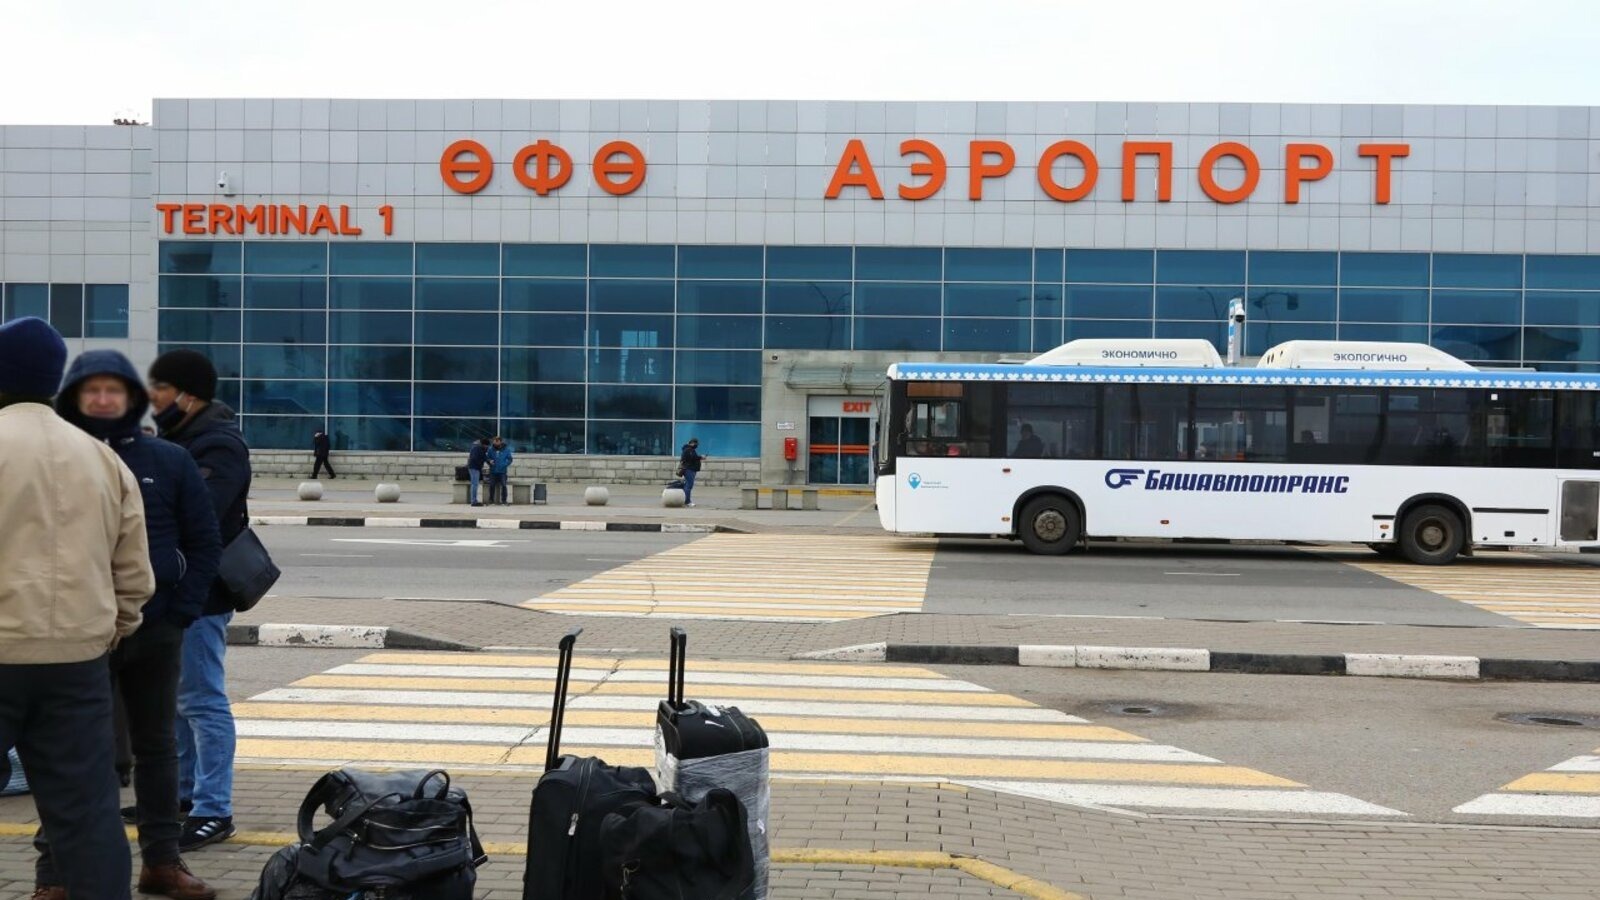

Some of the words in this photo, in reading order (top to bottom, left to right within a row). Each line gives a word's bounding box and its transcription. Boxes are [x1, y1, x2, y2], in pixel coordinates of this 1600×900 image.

[825, 138, 1410, 205] АЭРОПОРТ
[157, 203, 362, 236] TERMINAL
[378, 205, 394, 236] 1
[1101, 350, 1178, 359] ЭКОНОМИЧНО
[1333, 352, 1408, 362] ЭКОЛОГИЧНО
[843, 402, 872, 413] EXIT
